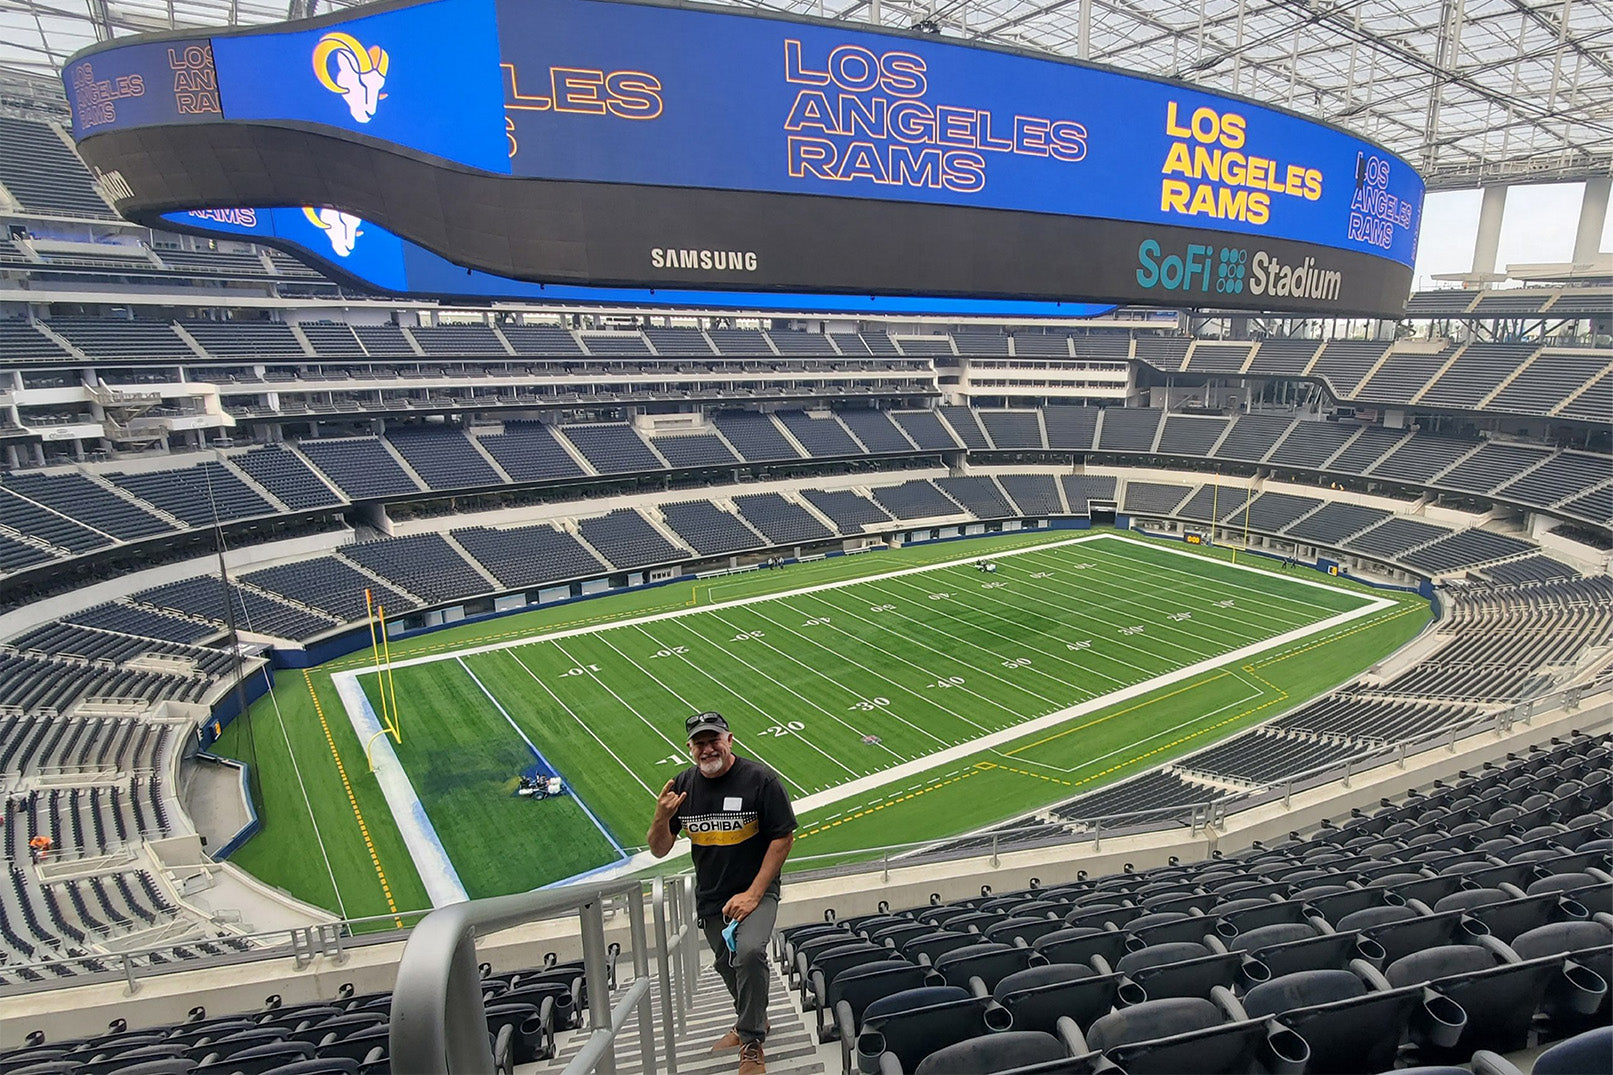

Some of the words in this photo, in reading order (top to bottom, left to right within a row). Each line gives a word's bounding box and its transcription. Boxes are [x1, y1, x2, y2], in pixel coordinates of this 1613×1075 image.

[784, 39, 928, 98] LOS
[174, 69, 218, 92] AN
[176, 92, 221, 114] RA
[784, 89, 1088, 161] ANGELES
[1166, 101, 1247, 149] LOS
[787, 135, 986, 192] RAMS
[1162, 142, 1323, 201] ANGELES
[1161, 179, 1270, 225] RAMS
[1351, 185, 1412, 230] ANGELES
[1348, 211, 1393, 249] RAMS
[651, 248, 757, 271] SAMSUNG
[1136, 239, 1214, 292] SoFi
[1249, 251, 1341, 300] Stadium
[735, 630, 765, 640] 30
[656, 645, 689, 657] 20
[567, 664, 602, 677] 10
[1001, 657, 1032, 669] 50
[937, 676, 965, 688] 40
[855, 697, 890, 711] 30
[767, 721, 805, 737] 20
[688, 820, 743, 833] COHIBA
